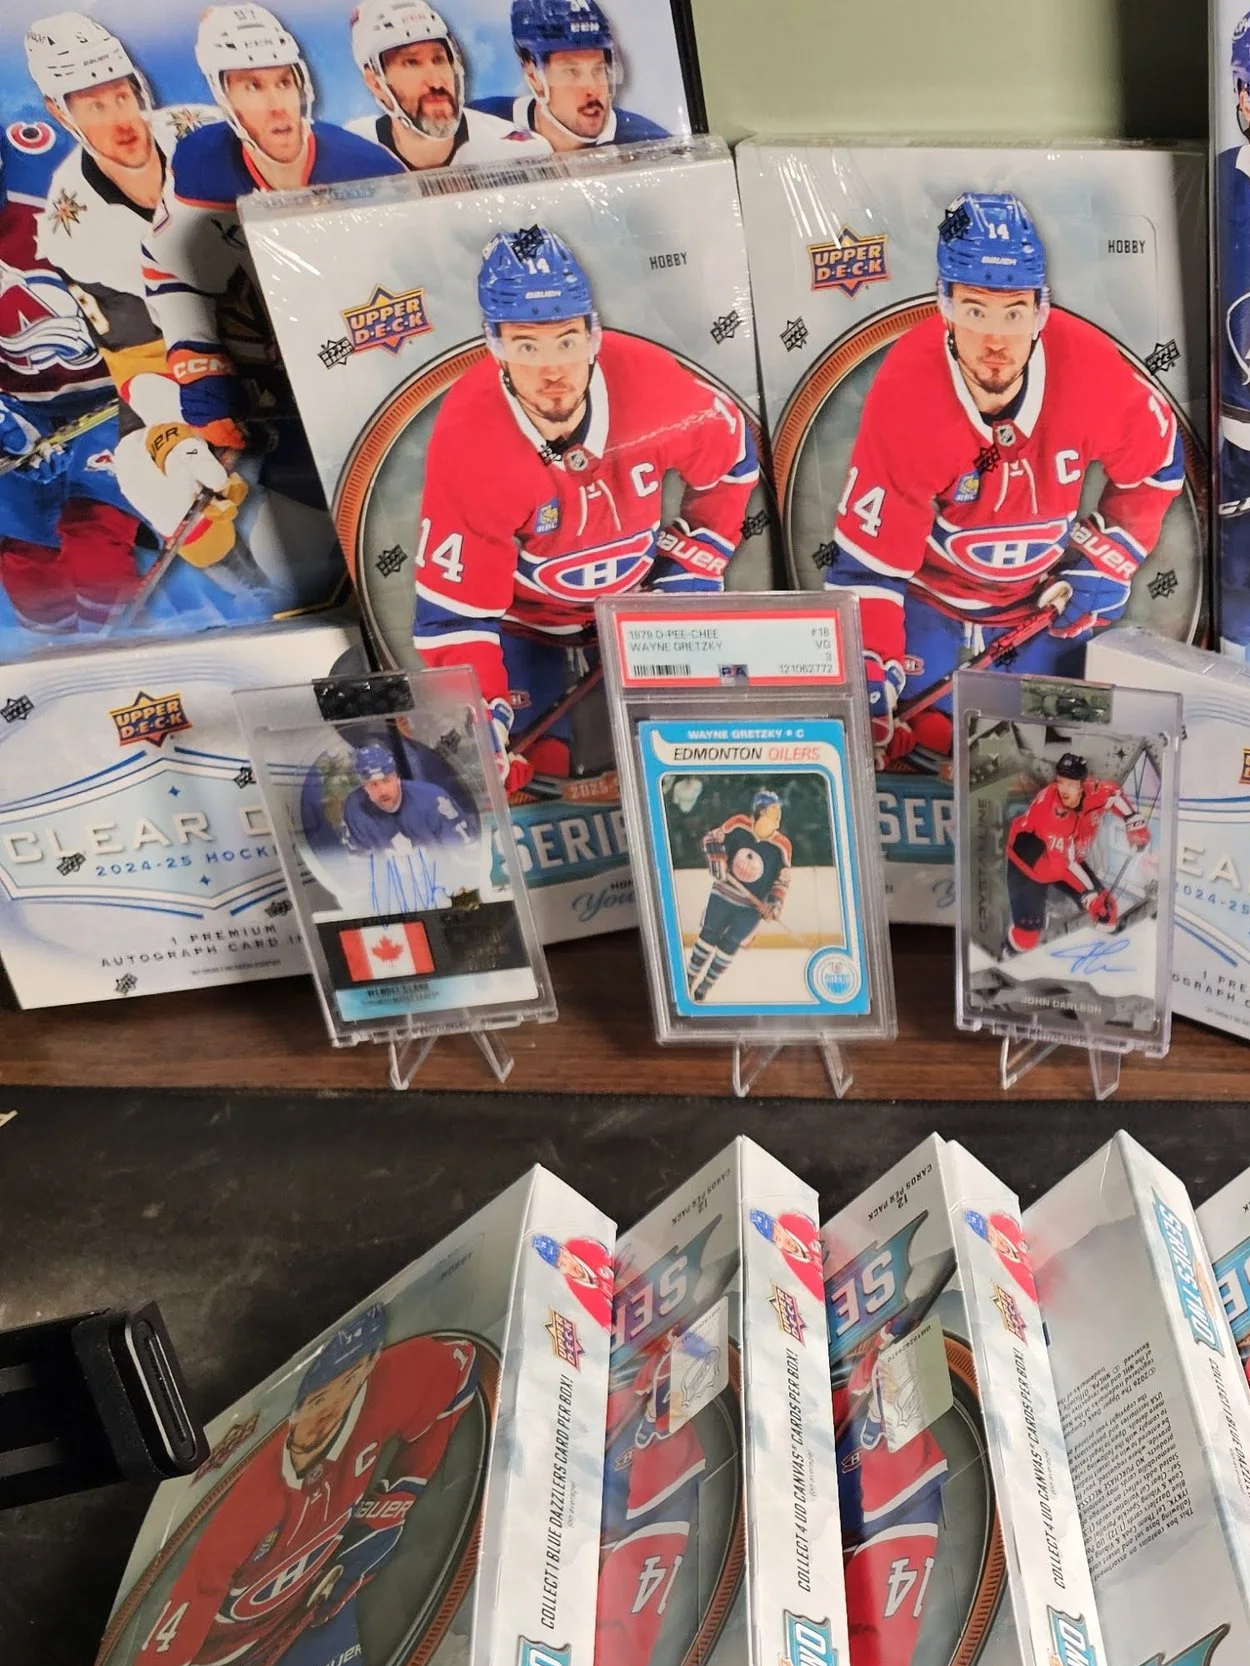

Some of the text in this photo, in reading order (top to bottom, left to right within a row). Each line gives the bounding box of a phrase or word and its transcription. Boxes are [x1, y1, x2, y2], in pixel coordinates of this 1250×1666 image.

[649, 252, 688, 270] HOBBY
[815, 246, 882, 268] UPPER
[1108, 240, 1145, 254] HOBBY
[351, 299, 421, 331] UPPER
[117, 700, 181, 726] UPPER
[687, 729, 729, 740] WAYNE
[673, 747, 821, 762] EDMONTON OILERS
[3, 811, 215, 865] CLEAR
[100, 943, 218, 968] AUTOGRAPH
[228, 937, 280, 952] CARD
[1172, 973, 1236, 1003] OGRAPH
[869, 1163, 932, 1222] CARDS PER PACK
[1159, 1203, 1198, 1291] SERIES
[786, 1348, 799, 1384] BOX!
[561, 1374, 574, 1413] BOX!
[789, 1383, 801, 1405] PER
[559, 1411, 571, 1433] PER
[790, 1405, 803, 1446] CARDS
[555, 1431, 569, 1464] CARD
[550, 1462, 567, 1528] DAZZLERS
[795, 1500, 807, 1524] UD
[547, 1526, 562, 1563] BLUE
[798, 1537, 812, 1593] COLLECT
[541, 1573, 560, 1630] COLLECT
